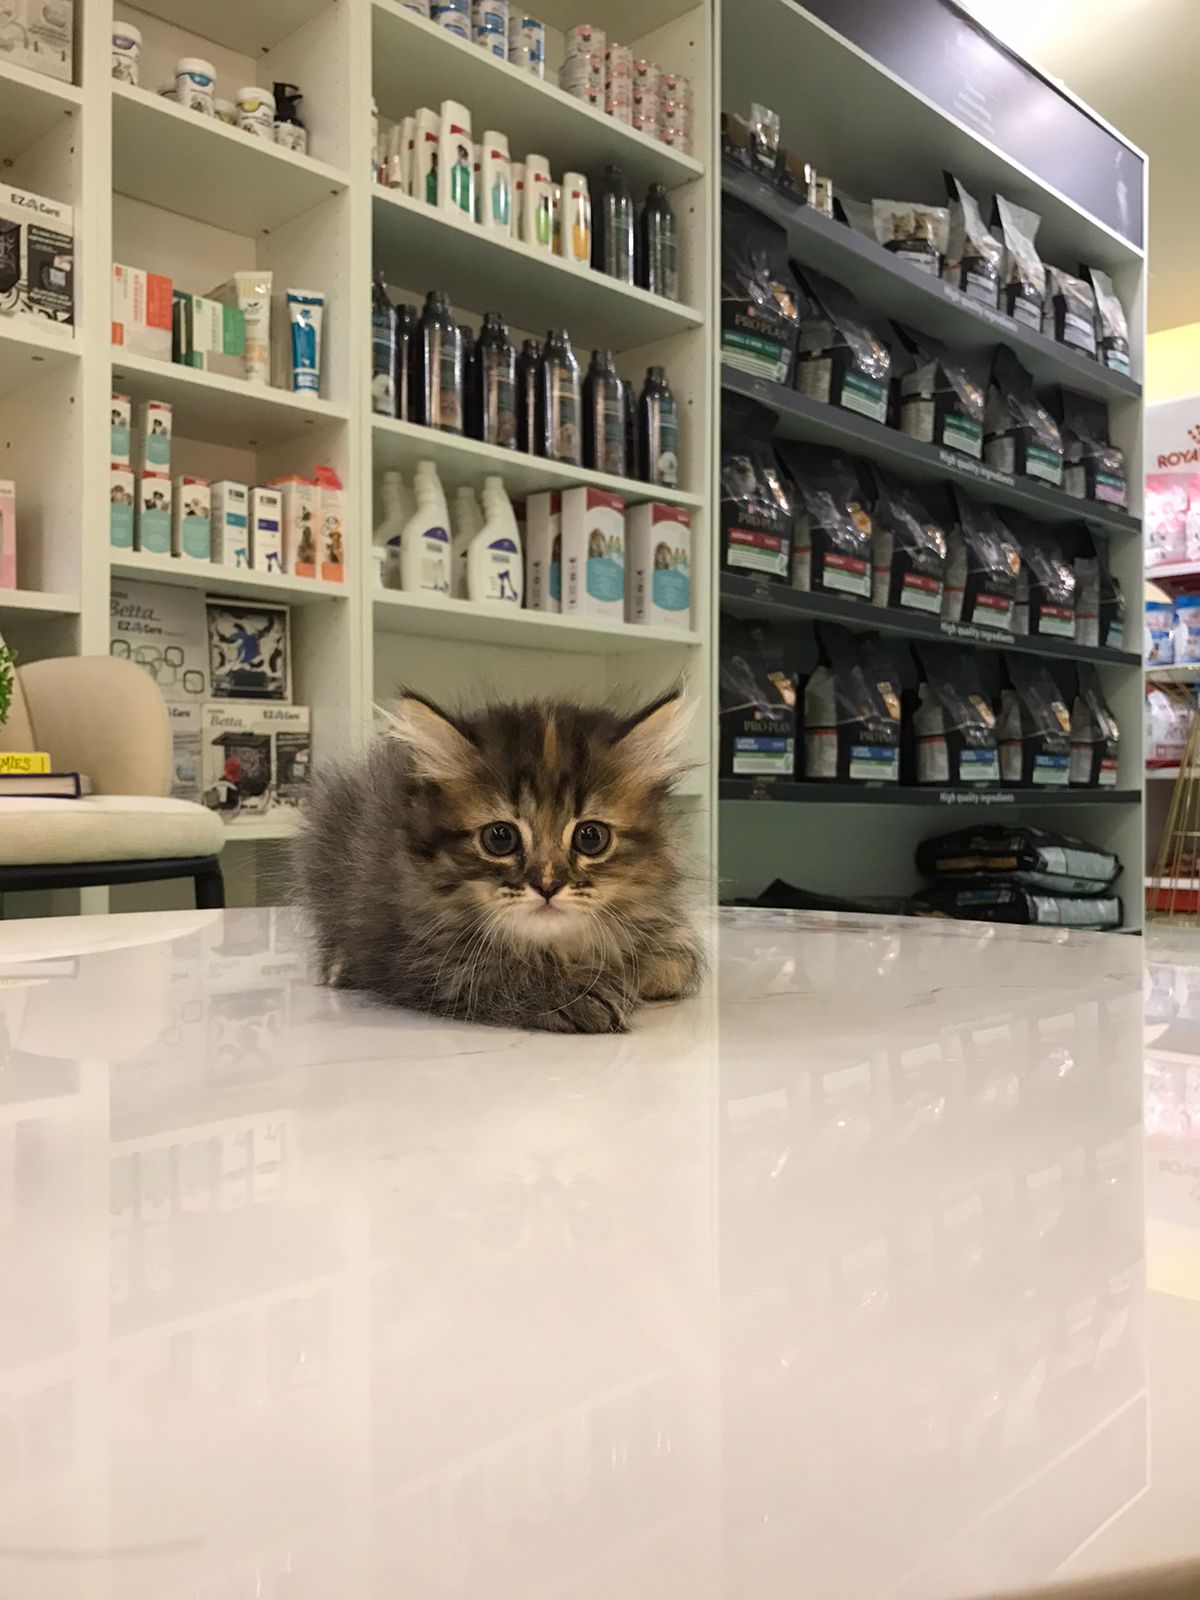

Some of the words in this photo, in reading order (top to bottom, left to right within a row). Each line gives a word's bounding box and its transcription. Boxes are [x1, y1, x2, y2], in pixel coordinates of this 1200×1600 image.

[940, 621, 956, 636] High
[743, 720, 767, 733] PRO
[940, 791, 956, 805] High
